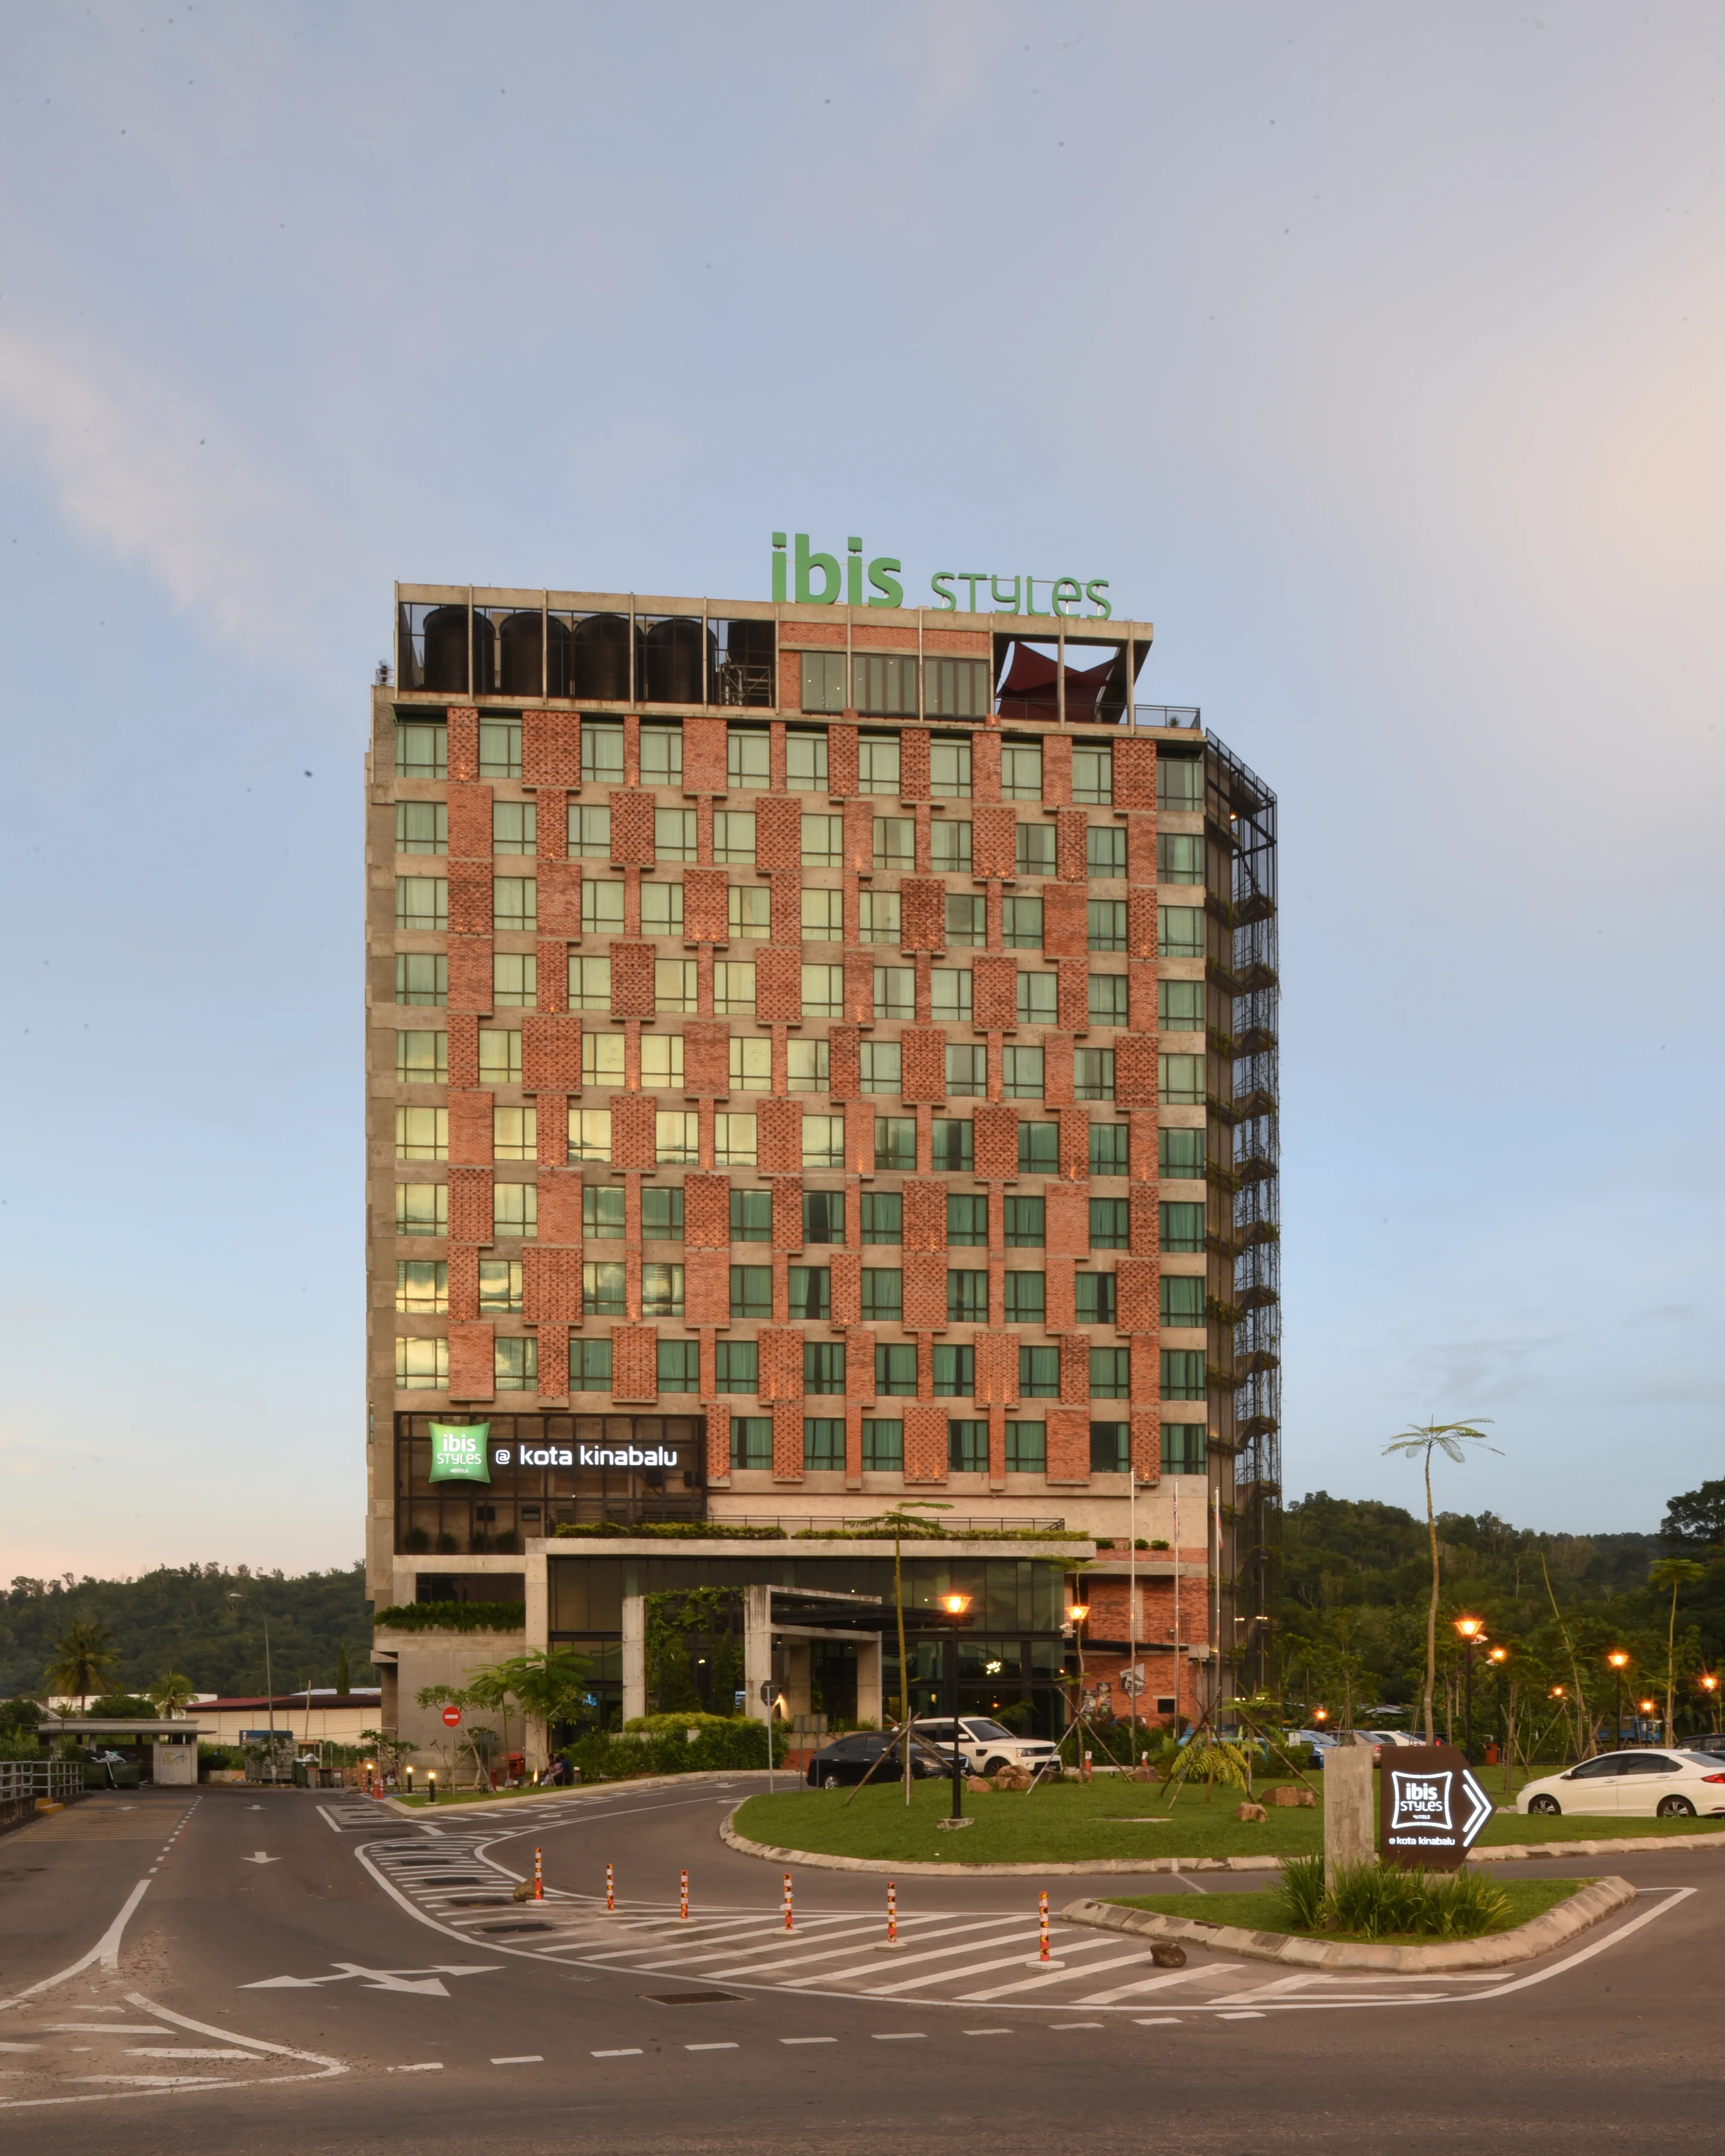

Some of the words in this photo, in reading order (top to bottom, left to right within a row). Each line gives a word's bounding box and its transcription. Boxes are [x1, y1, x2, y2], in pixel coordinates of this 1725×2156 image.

[772, 532, 903, 609] ibis
[443, 1434, 476, 1452] ibis
[495, 1449, 510, 1465] @
[520, 1445, 573, 1465] kota
[580, 1445, 677, 1466] kinabalu
[1406, 1783, 1438, 1800] ibis
[1396, 1836, 1417, 1845] kota
[1418, 1836, 1455, 1845] kinabalu
